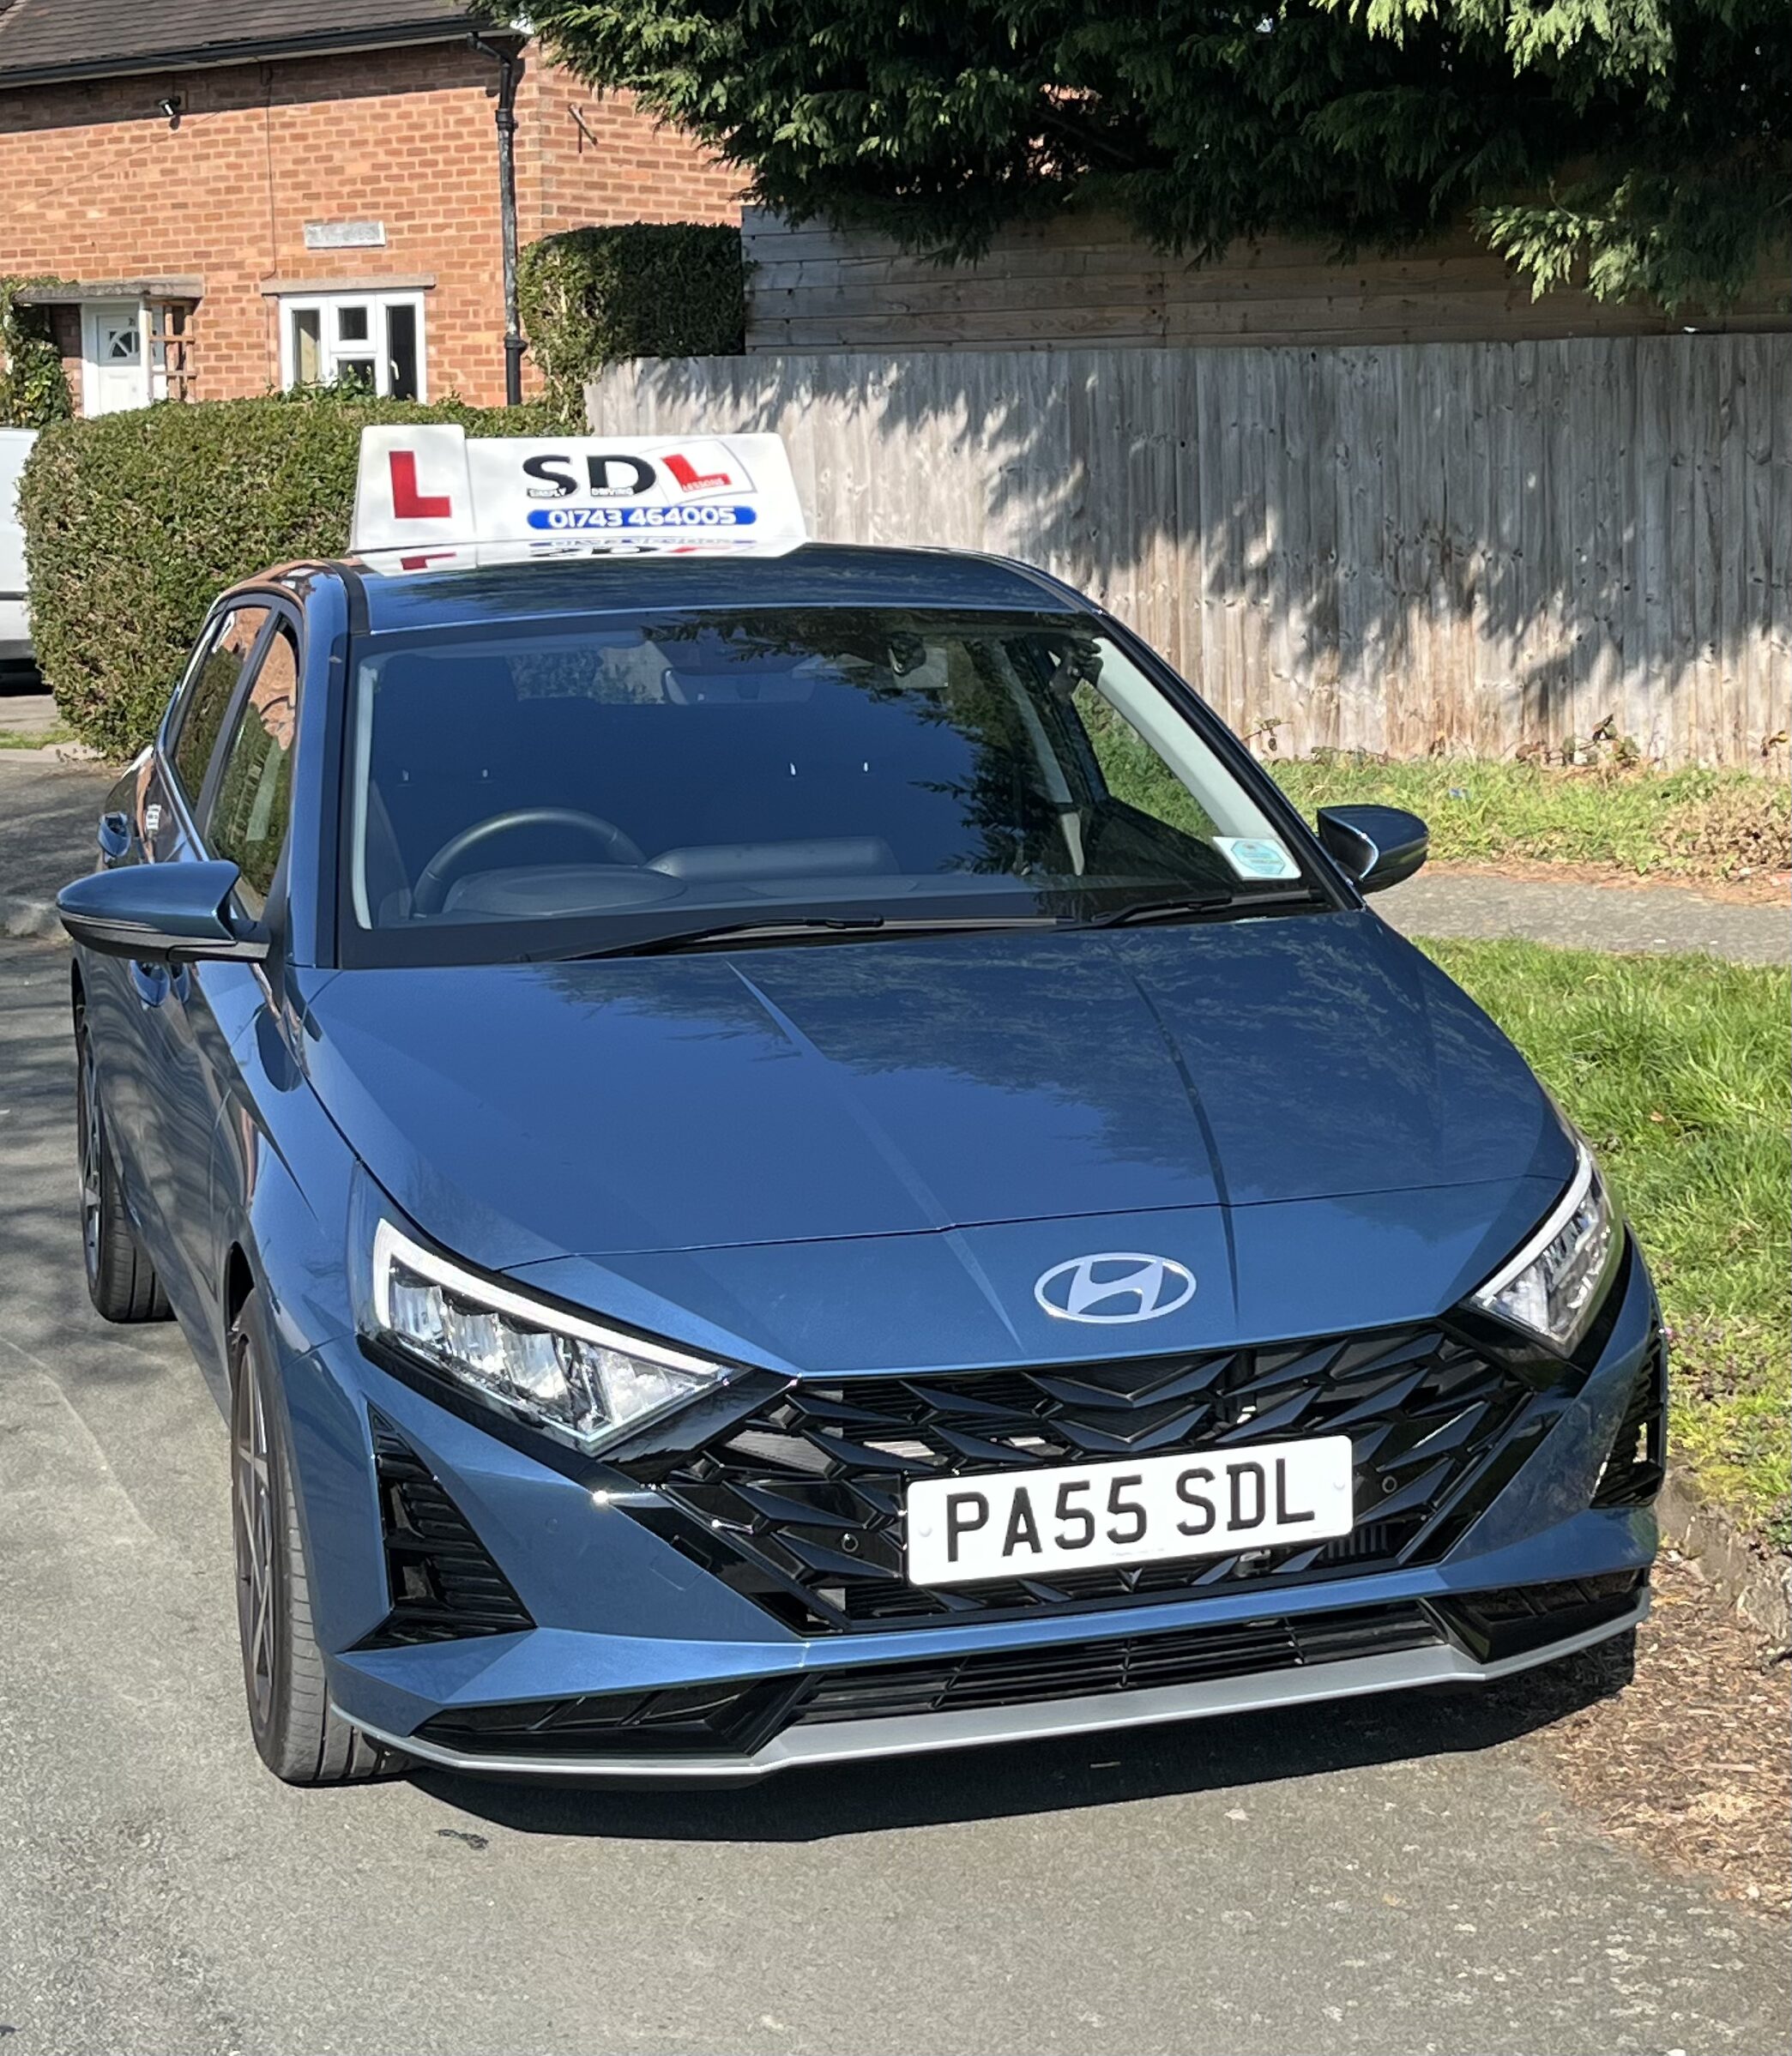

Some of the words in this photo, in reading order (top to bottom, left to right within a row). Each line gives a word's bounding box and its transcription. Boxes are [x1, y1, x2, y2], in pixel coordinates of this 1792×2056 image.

[389, 450, 451, 518] L
[547, 509, 624, 528] 01743
[628, 506, 737, 526] 464005
[946, 1474, 1148, 1562] PA55
[1176, 1458, 1315, 1536] SDL
